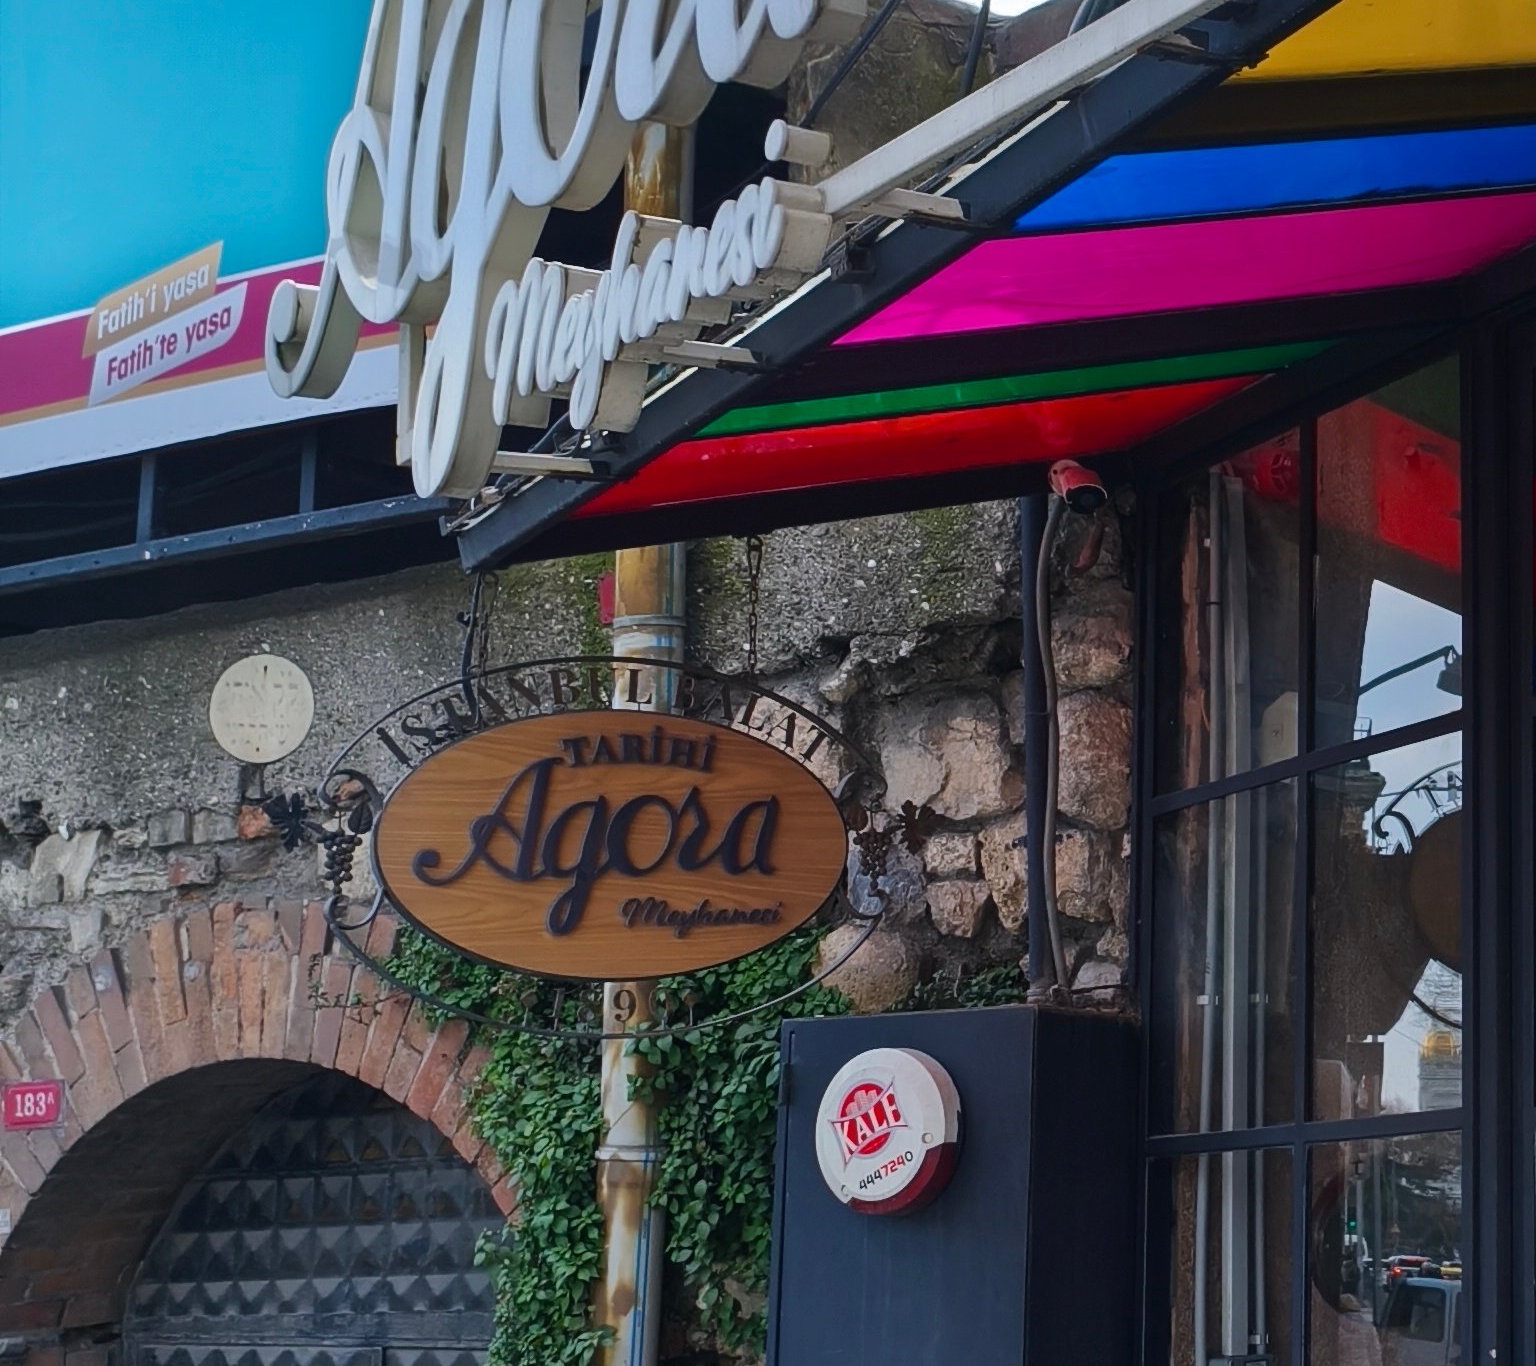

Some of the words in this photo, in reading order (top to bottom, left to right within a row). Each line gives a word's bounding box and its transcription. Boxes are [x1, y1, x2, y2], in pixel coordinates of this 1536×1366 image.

[484, 119, 786, 431] Meyhanesi
[106, 332, 178, 386] Fatih'te
[559, 724, 717, 774] TARİHİ
[412, 756, 781, 938] Agora
[619, 895, 785, 939] Meyhanesi
[832, 1084, 907, 1162] KALE
[858, 1150, 914, 1191] 4447240
